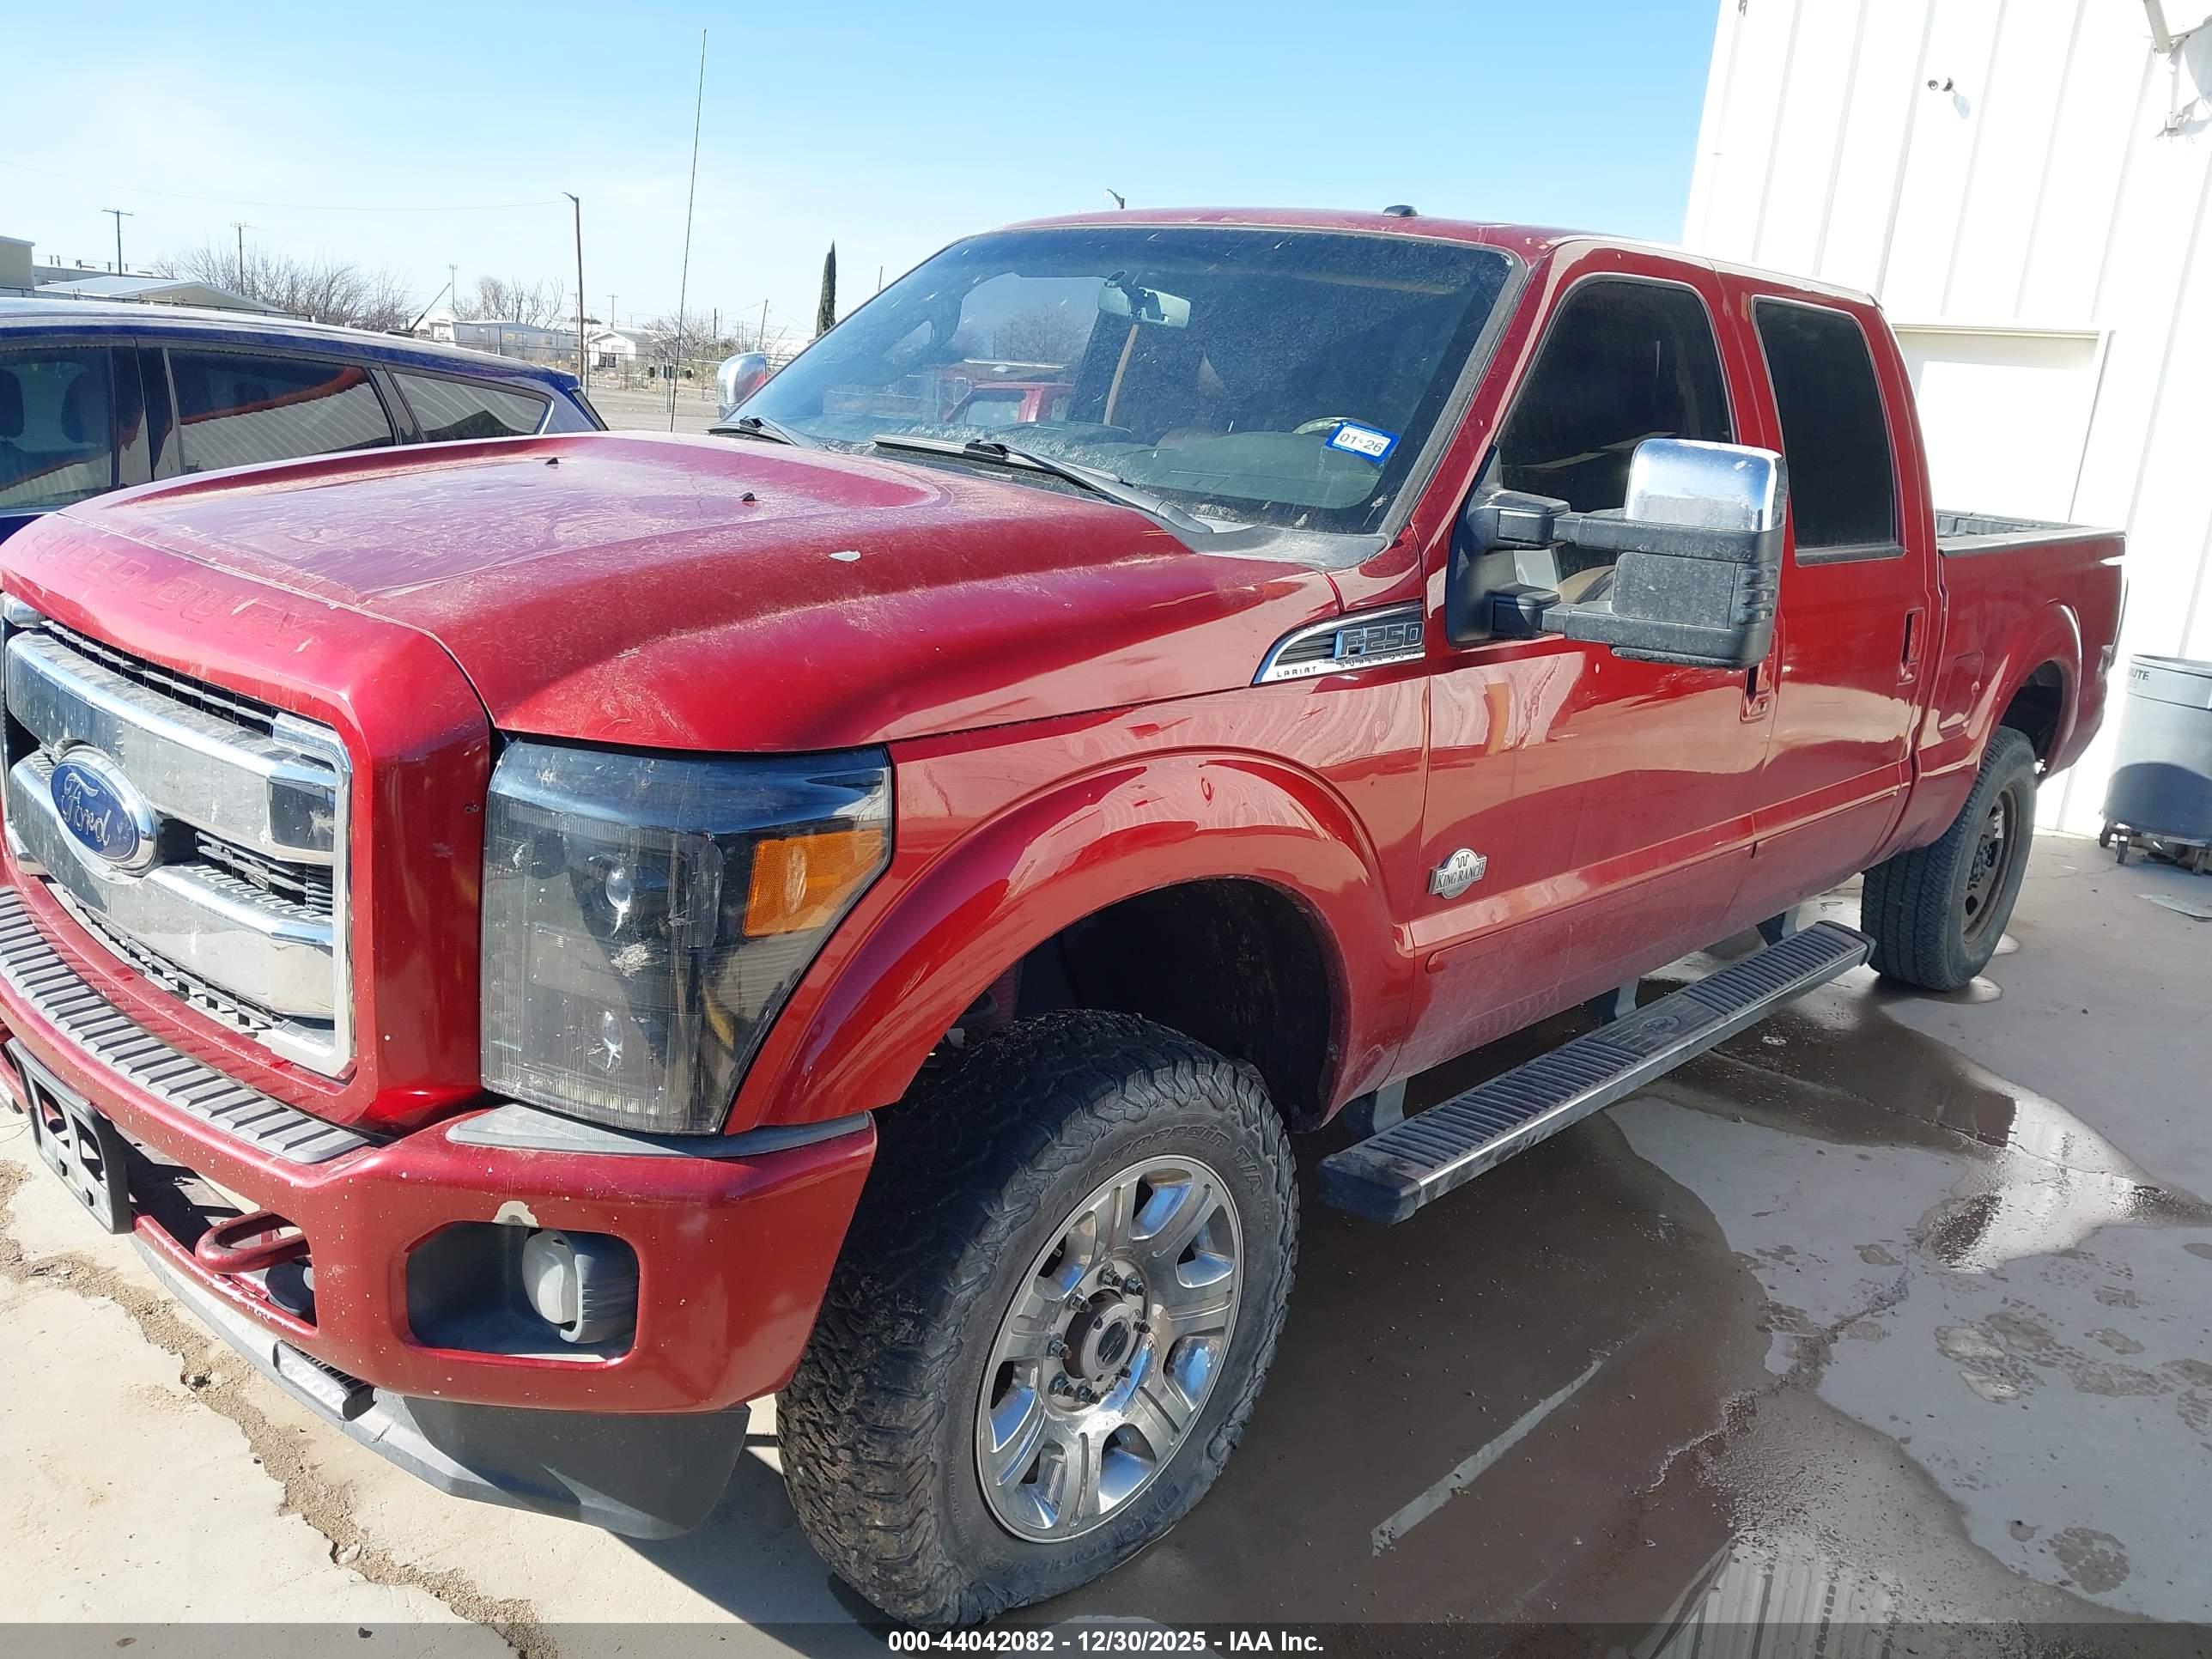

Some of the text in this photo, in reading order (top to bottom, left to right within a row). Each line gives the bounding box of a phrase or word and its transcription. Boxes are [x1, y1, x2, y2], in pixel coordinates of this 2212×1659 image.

[1335, 621, 1425, 659] F-250
[1277, 665, 1317, 678] LARIAT
[1340, 655, 1382, 668] SUPER
[61, 772, 111, 847] Ford
[1437, 872, 1457, 889] KING
[1456, 861, 1485, 882] RANCH
